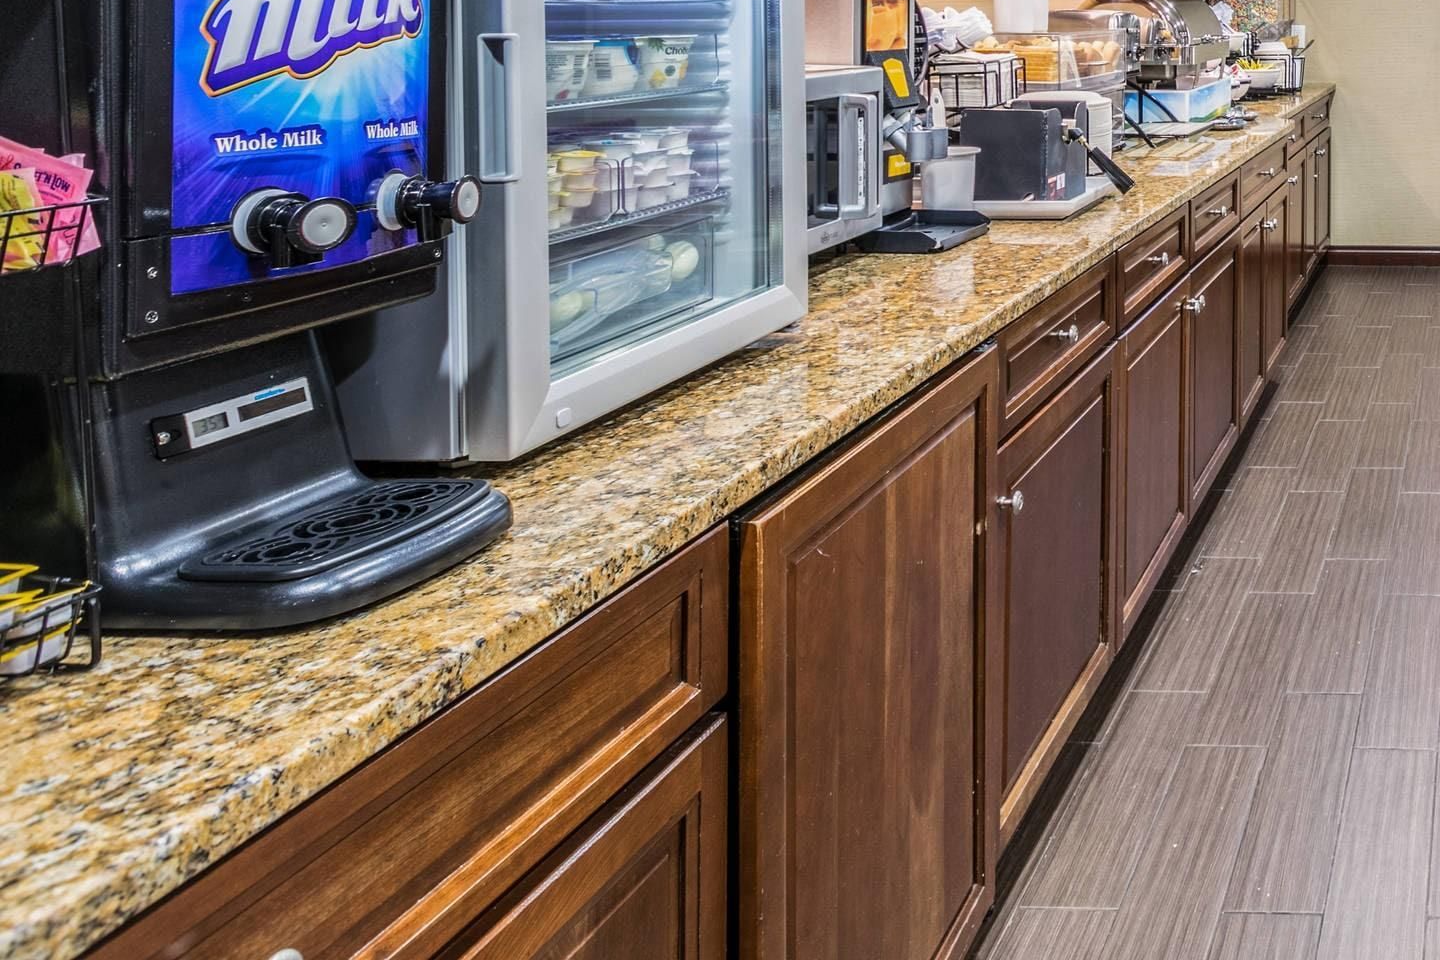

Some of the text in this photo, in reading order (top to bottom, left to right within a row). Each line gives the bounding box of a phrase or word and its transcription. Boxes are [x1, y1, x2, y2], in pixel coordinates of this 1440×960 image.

[366, 120, 419, 140] Whole Milk
[215, 130, 323, 154] Whole Milk
